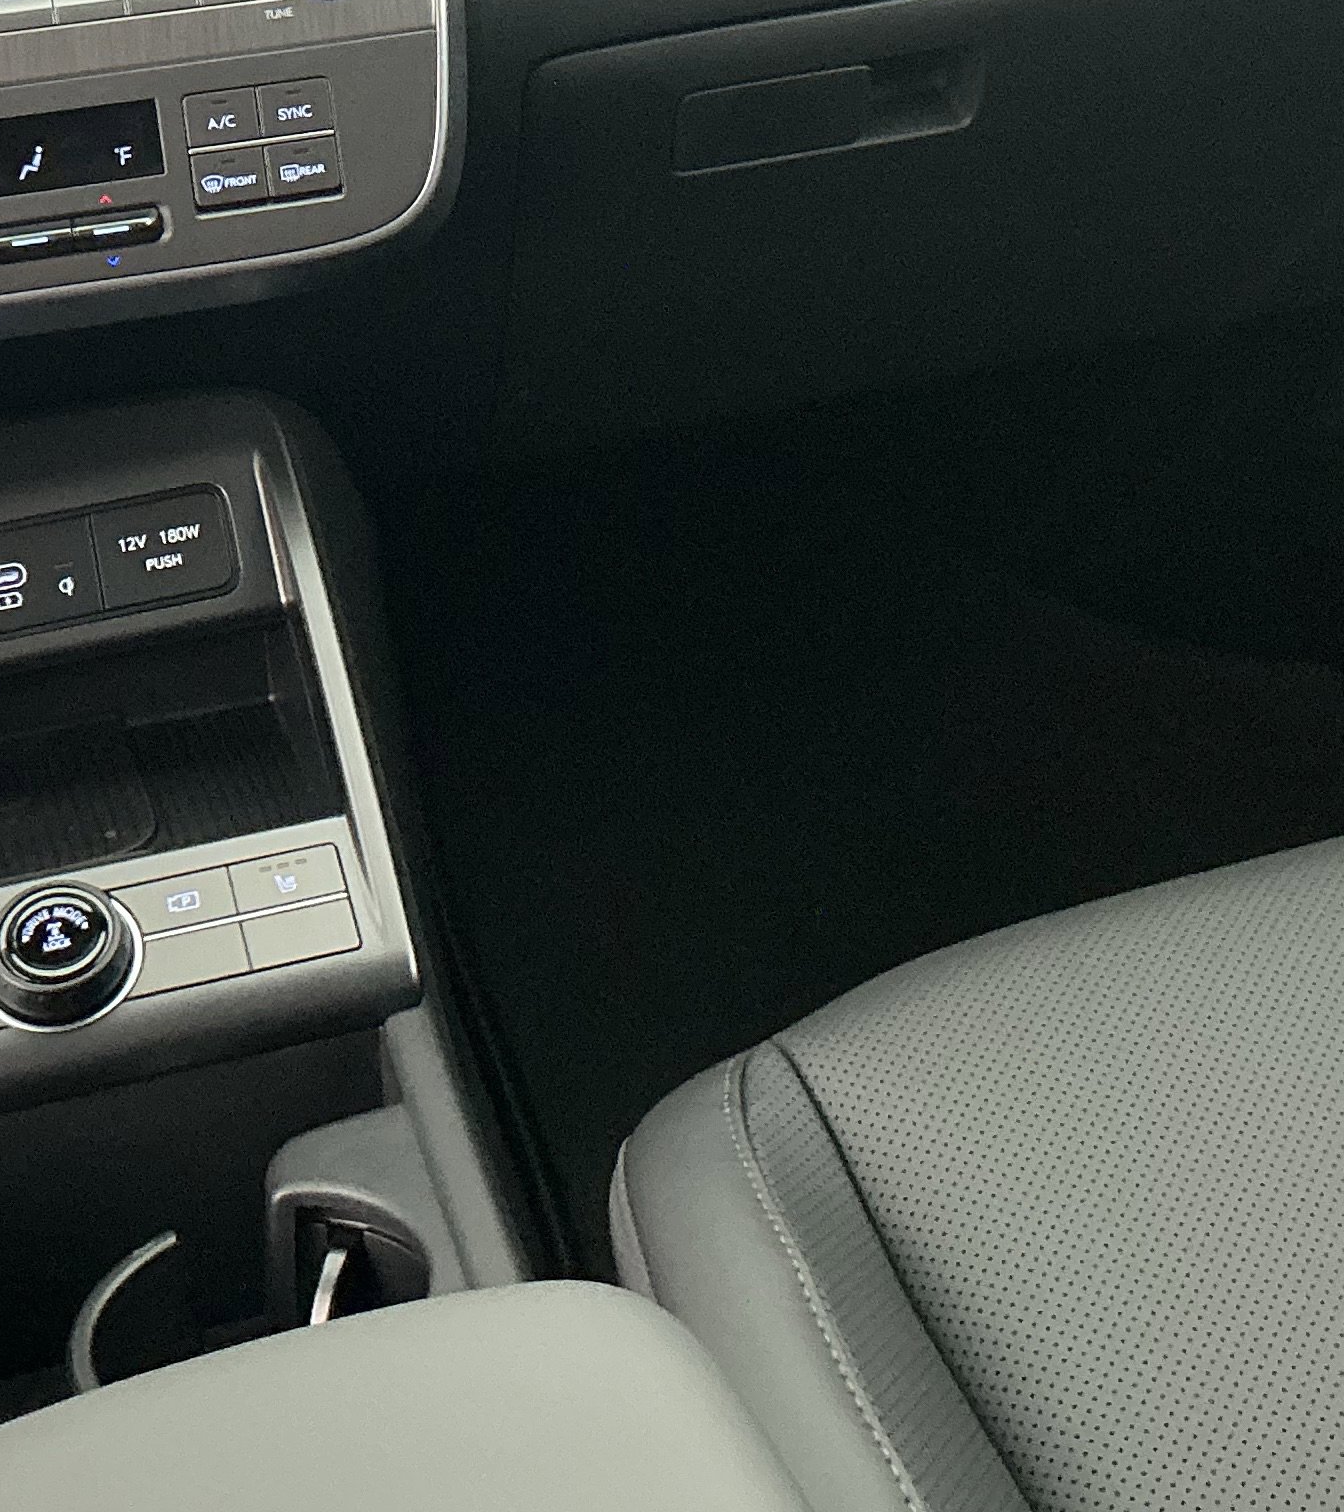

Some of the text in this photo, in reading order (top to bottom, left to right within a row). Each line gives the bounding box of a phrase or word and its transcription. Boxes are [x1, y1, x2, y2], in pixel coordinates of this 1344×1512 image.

[264, 6, 294, 21] TUNE
[277, 104, 313, 121] SYNC
[207, 114, 237, 130] A/C
[299, 163, 327, 176] REAR
[224, 174, 258, 188] FRONT
[117, 523, 201, 553] 12V 180W
[145, 553, 183, 571] PUSH
